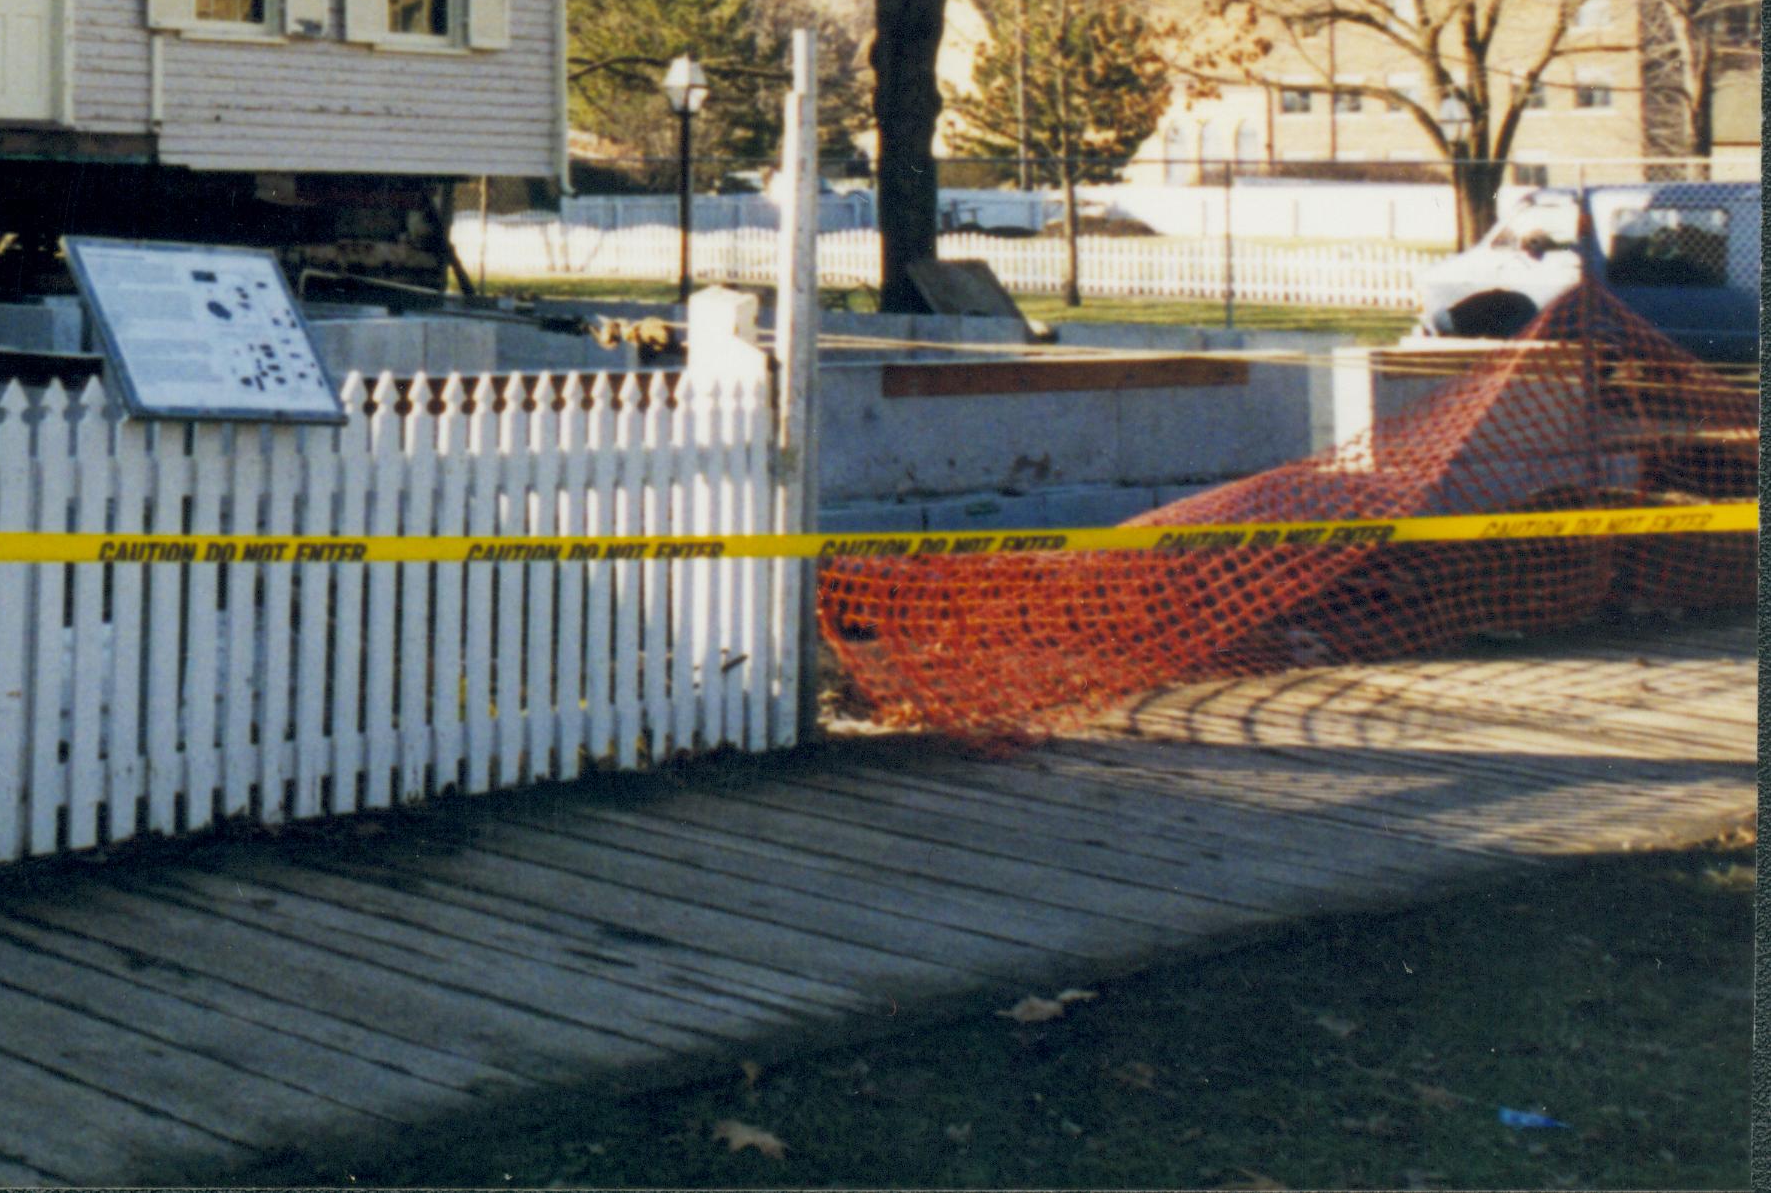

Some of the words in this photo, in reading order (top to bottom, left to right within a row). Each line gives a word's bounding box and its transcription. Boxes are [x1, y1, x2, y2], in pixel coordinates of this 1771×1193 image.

[1480, 519, 1564, 537] CAUTION
[1574, 518, 1602, 535] DO
[1608, 516, 1644, 533] NOT
[1651, 514, 1713, 531] ENTER
[99, 541, 196, 561] CAUTION
[205, 542, 236, 561] DO
[242, 543, 288, 562] NOT
[294, 543, 367, 562] ENTER
[467, 543, 562, 560] CAUTION
[568, 543, 600, 560] DO
[606, 543, 649, 559] NOT
[655, 541, 725, 559] ENTER
[820, 538, 912, 556] CAUTION
[918, 537, 947, 554] DO
[951, 536, 995, 553] NOT
[1000, 535, 1067, 552] ENTER
